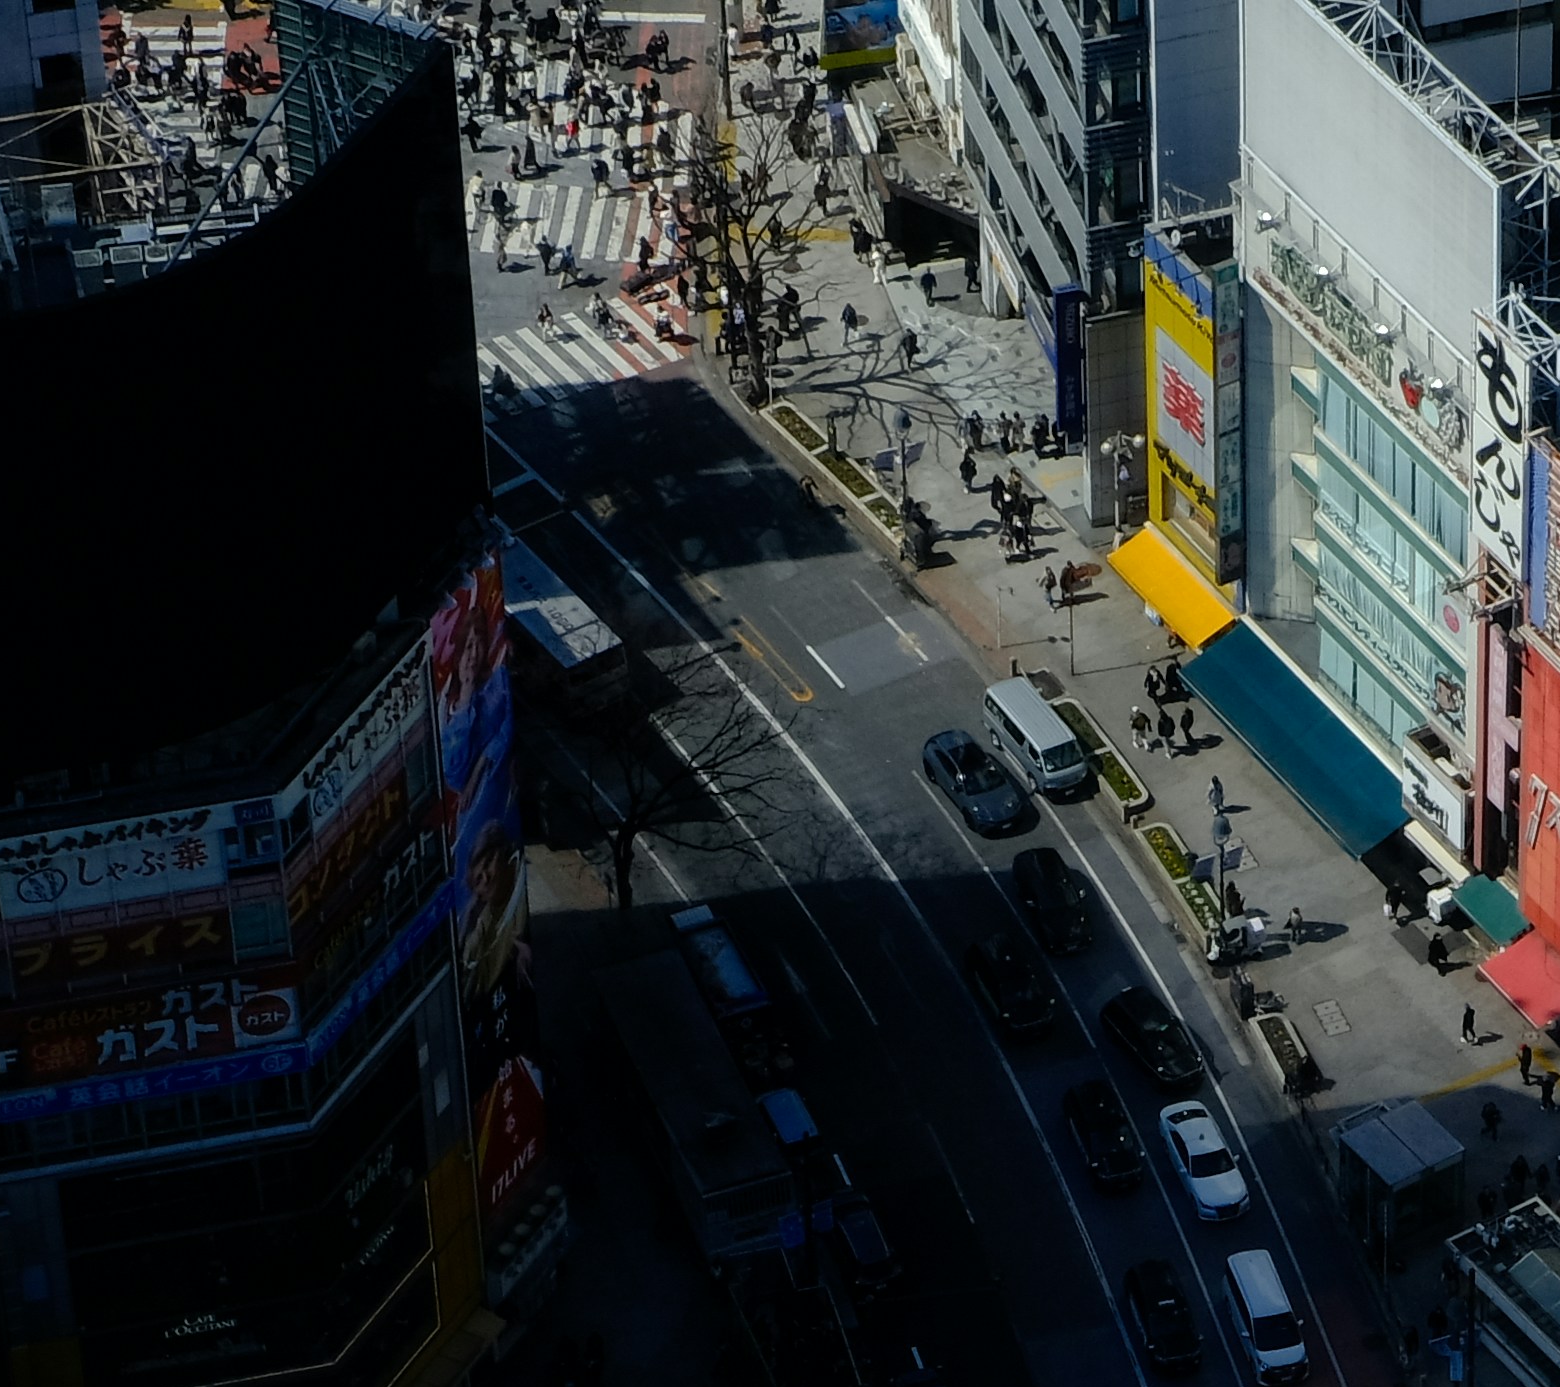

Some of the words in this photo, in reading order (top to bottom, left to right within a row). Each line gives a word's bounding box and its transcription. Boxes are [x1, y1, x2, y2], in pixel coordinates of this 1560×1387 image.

[77, 836, 209, 887] しゃぶ葉
[160, 977, 261, 1015] ガスト
[245, 1010, 286, 1027] ガスト
[96, 1014, 220, 1066] ガスト
[491, 1137, 537, 1205] 17LIVE
